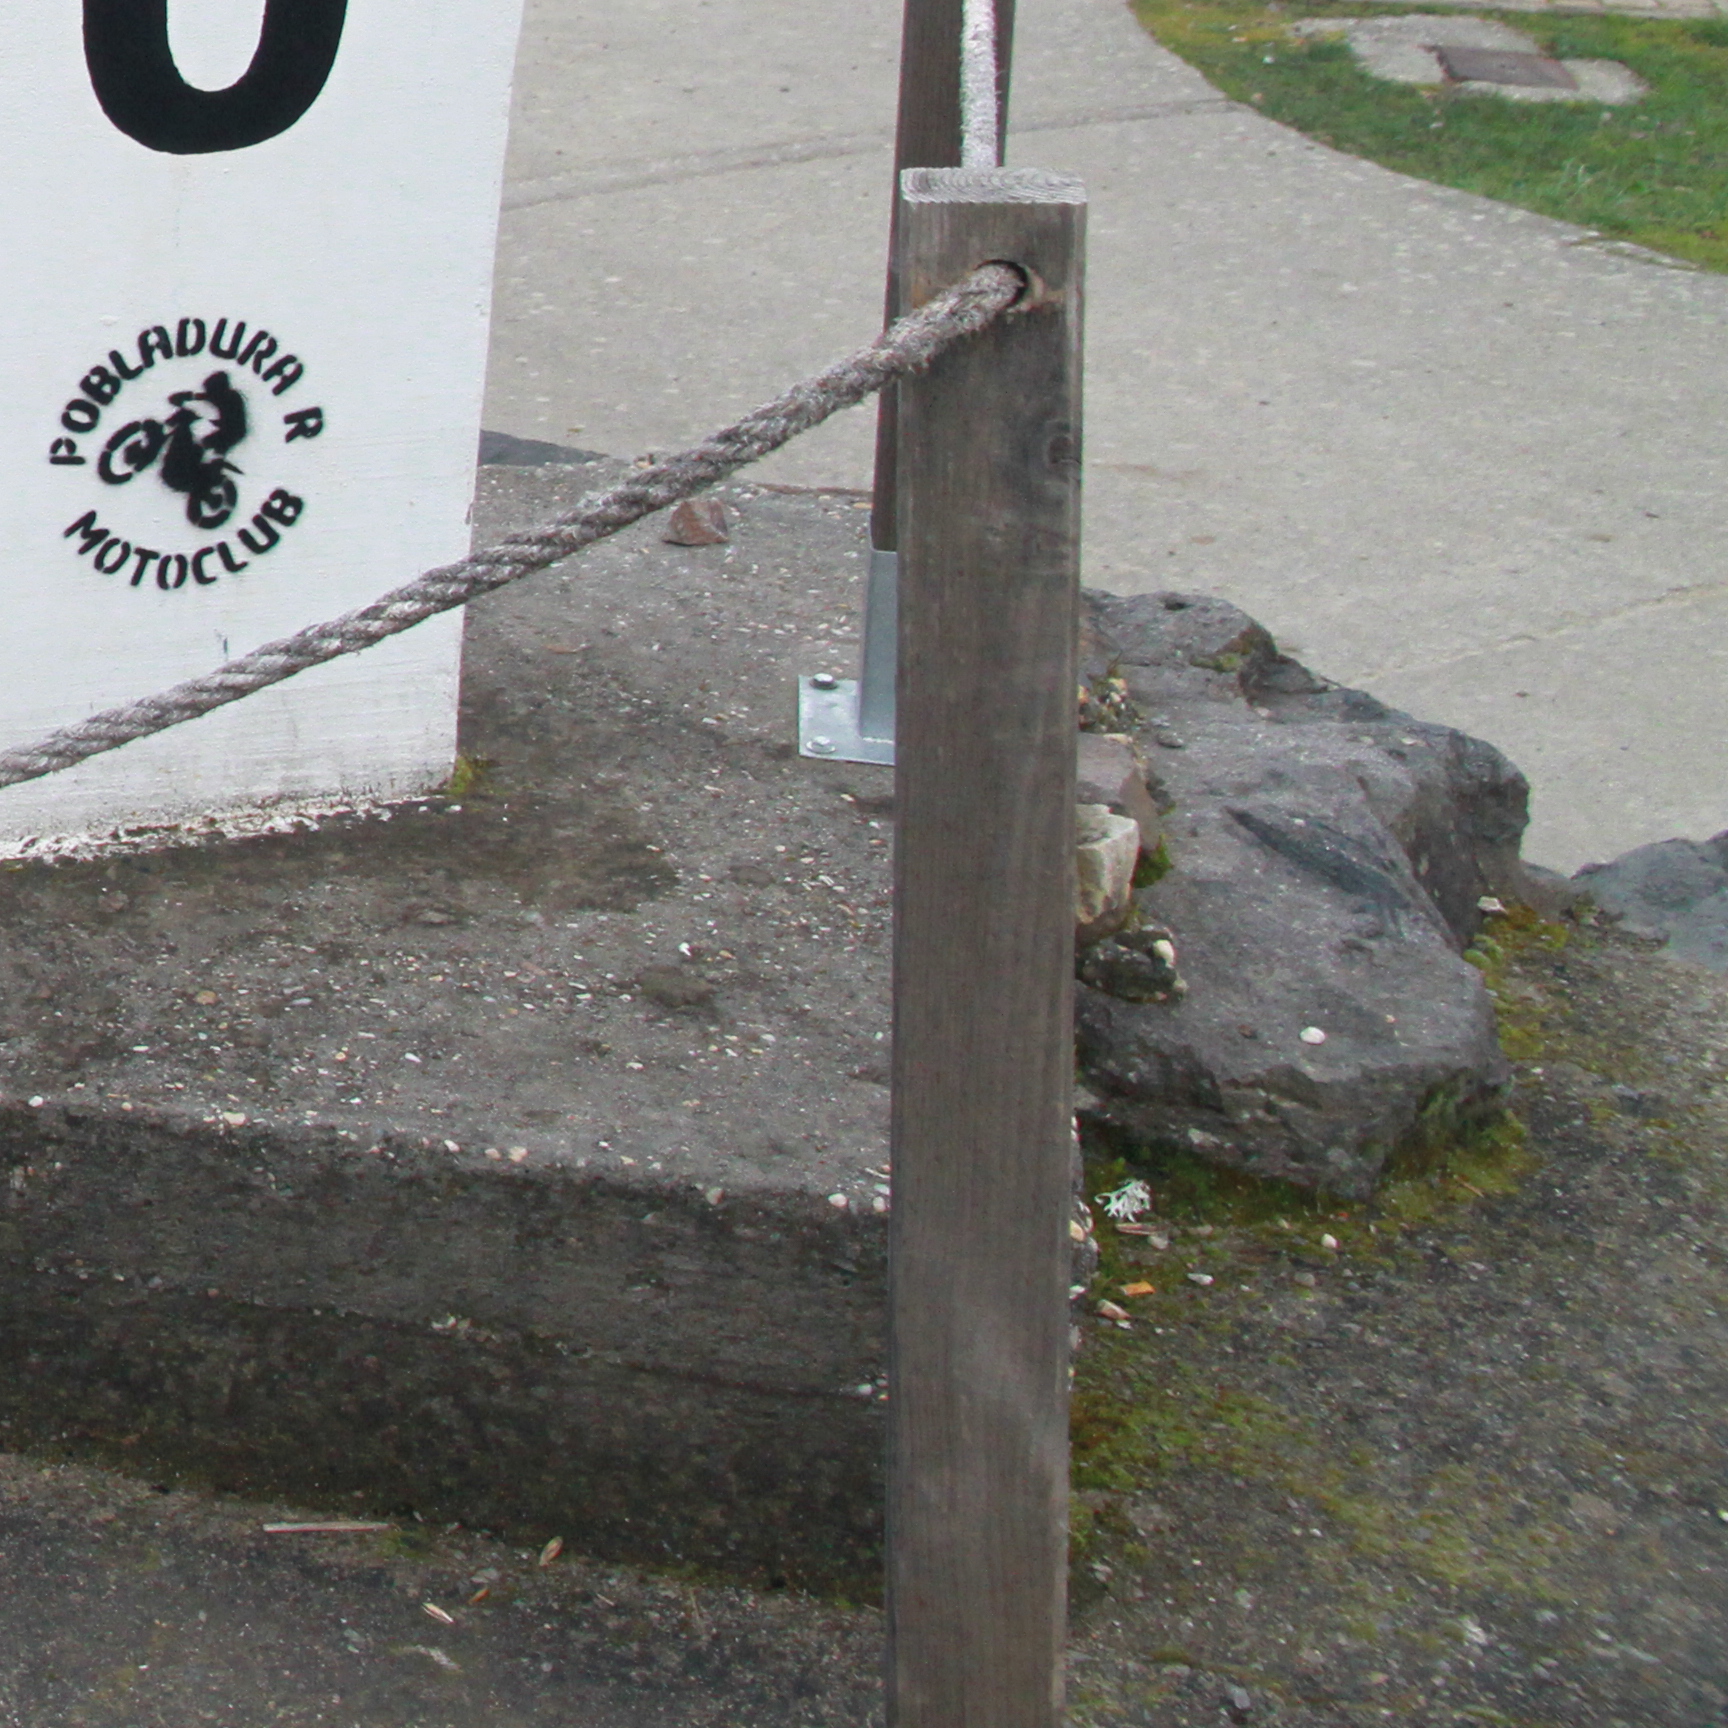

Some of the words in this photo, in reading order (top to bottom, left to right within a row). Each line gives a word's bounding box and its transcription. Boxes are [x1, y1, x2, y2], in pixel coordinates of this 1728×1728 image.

[49, 318, 304, 465] POBLADURA
[283, 406, 324, 443] R
[63, 489, 304, 590] MOTOCLUB
